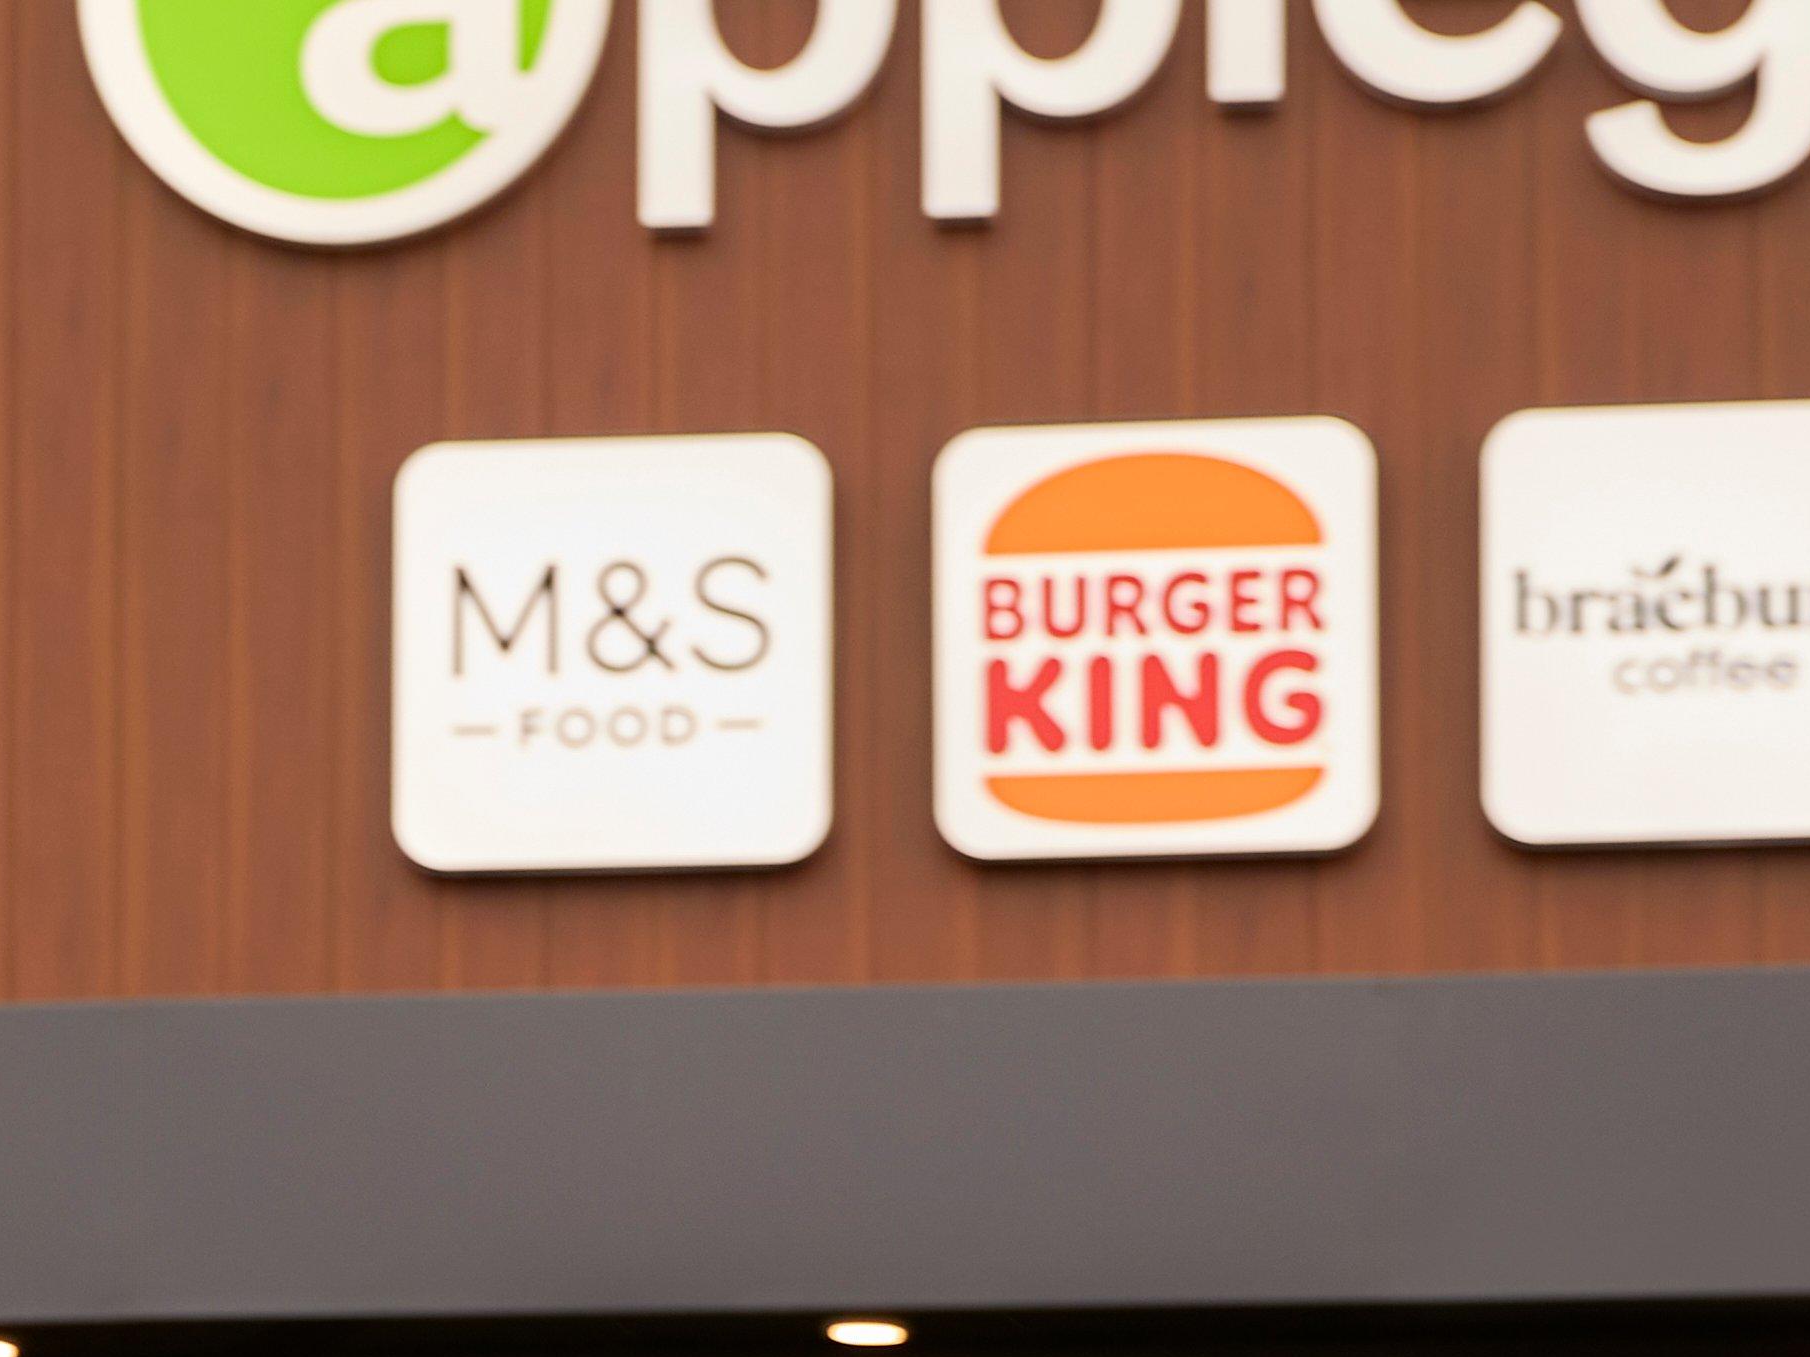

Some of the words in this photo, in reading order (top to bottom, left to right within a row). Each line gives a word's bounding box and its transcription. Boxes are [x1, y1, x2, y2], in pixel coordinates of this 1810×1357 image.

[452, 555, 772, 678] M&S
[982, 568, 1326, 641] BURGER
[984, 649, 1326, 754] KING
[1612, 648, 1799, 696] coffee
[517, 706, 697, 750] FOOD
